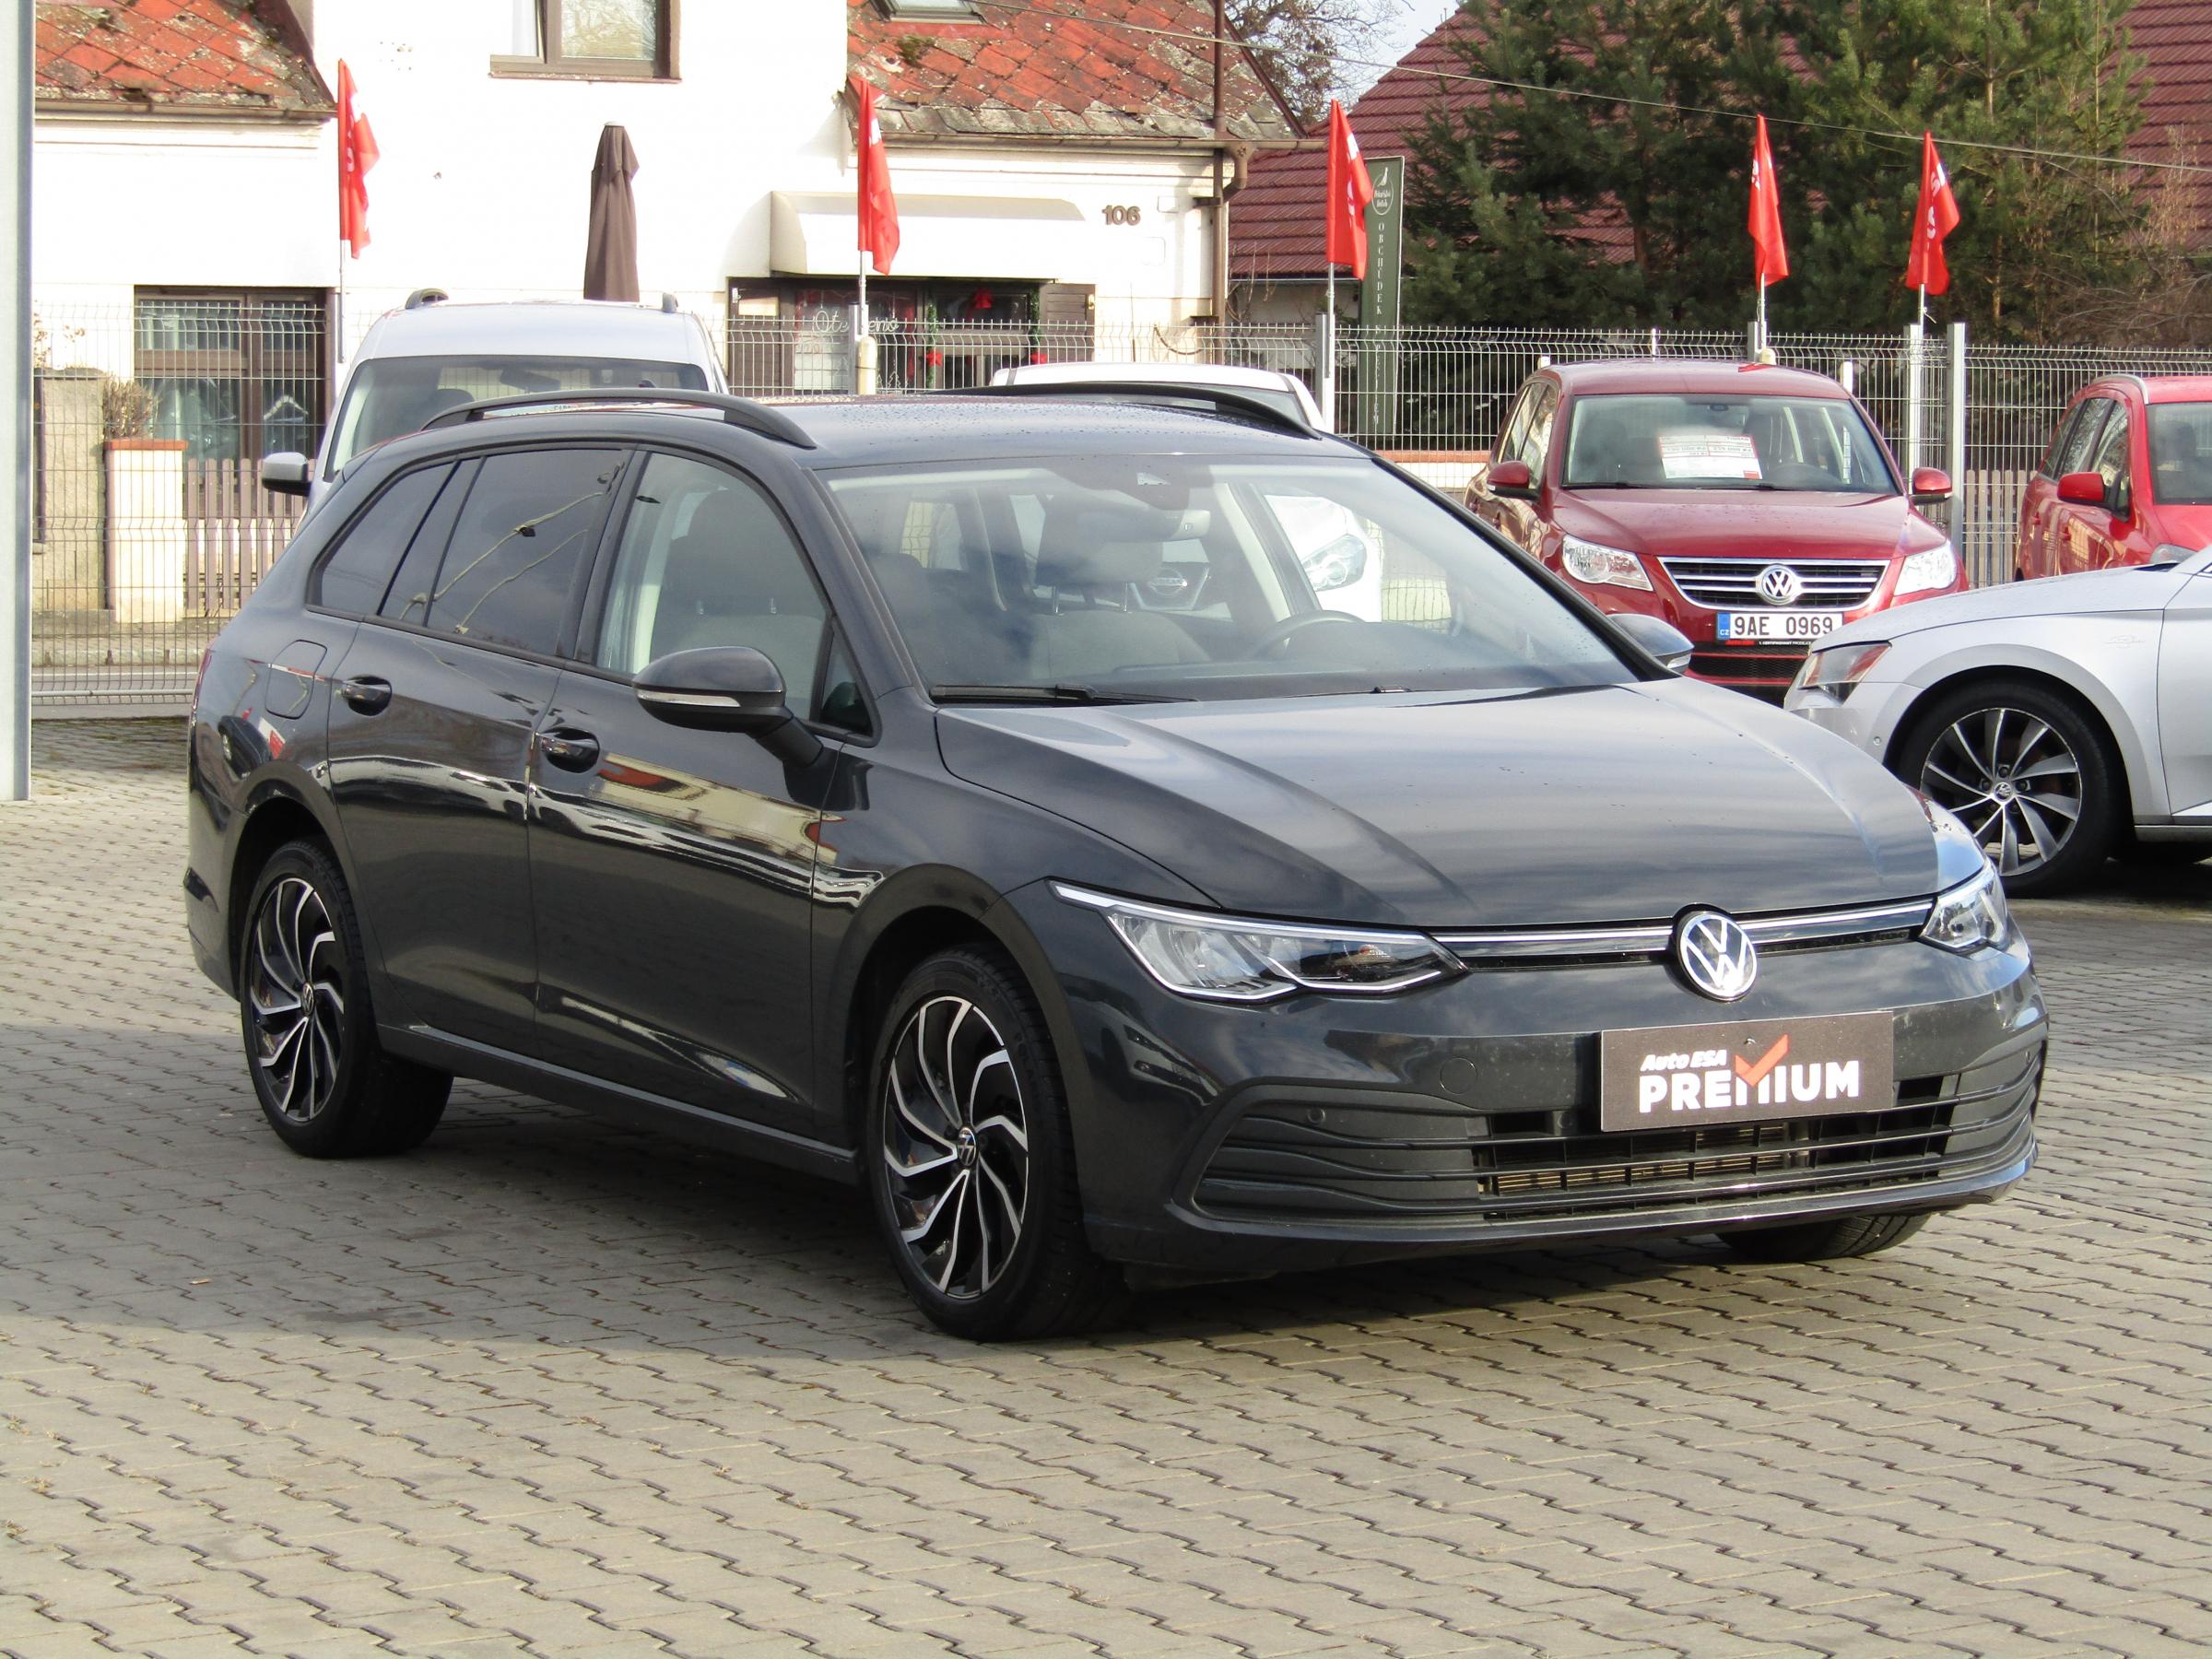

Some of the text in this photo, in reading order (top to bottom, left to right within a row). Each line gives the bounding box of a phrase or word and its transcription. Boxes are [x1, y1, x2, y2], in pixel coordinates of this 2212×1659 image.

[1101, 205, 1141, 226] 106
[1734, 617, 1833, 636] 9AE 0969
[1680, 914, 1757, 997] VW
[1640, 1049, 1727, 1072] Auto ESA
[1639, 1060, 1859, 1113] PREMIUM
